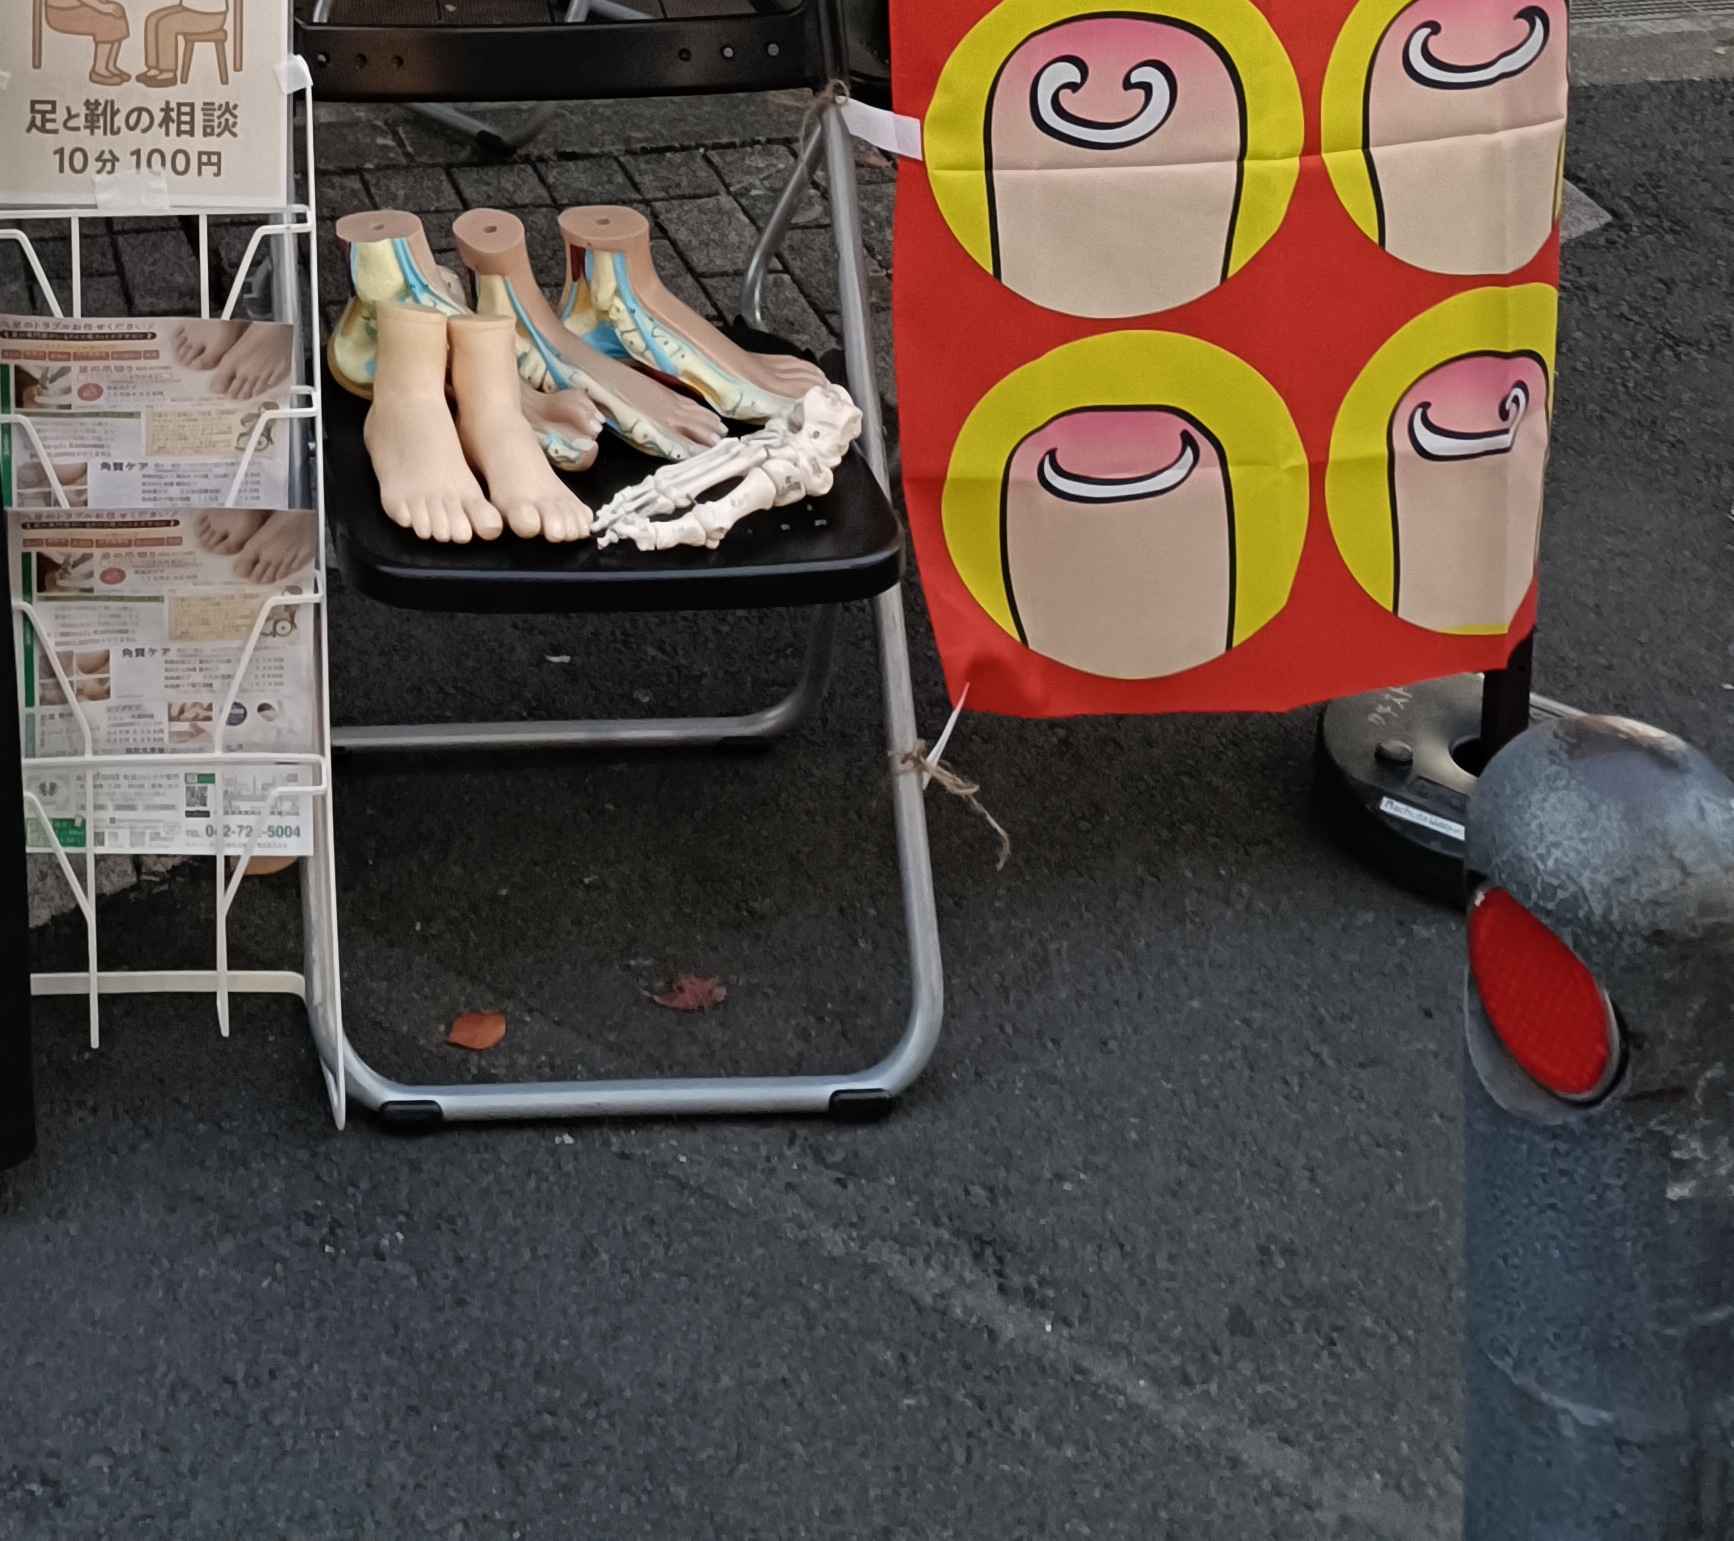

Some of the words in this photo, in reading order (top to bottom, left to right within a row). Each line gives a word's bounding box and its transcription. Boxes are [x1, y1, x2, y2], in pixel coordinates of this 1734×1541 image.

[25, 98, 240, 139] 足と靴の相談
[205, 824, 301, 839] 02-72-5004
